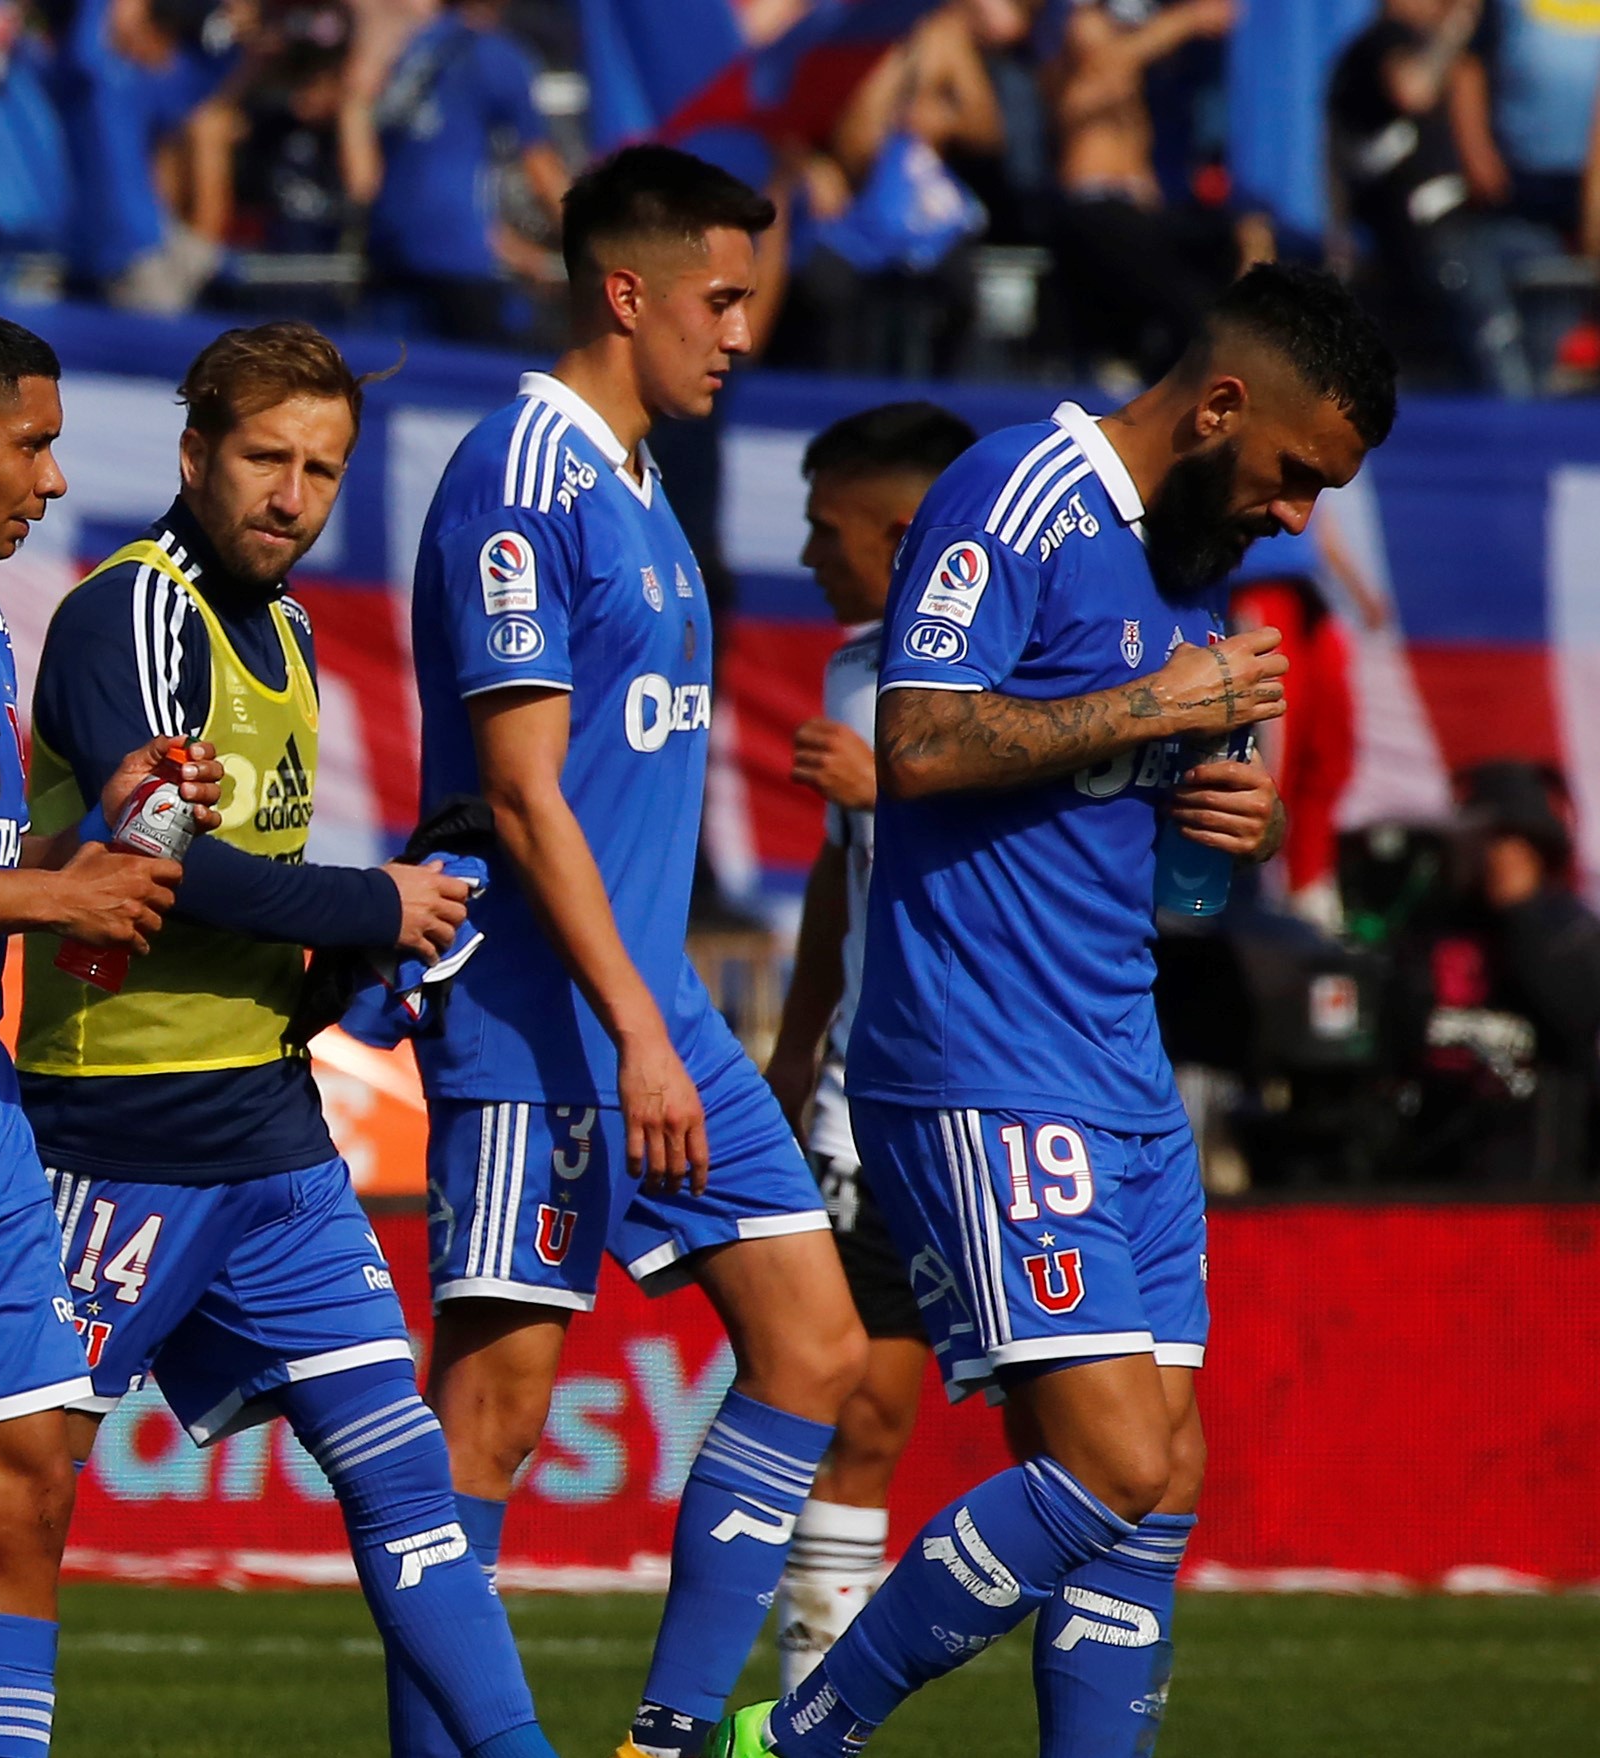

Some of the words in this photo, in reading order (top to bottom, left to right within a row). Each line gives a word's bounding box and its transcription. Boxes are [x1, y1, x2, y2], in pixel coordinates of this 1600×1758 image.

[501, 624, 529, 651] PF
[916, 627, 953, 654] PF
[1000, 1123, 1095, 1221] 19
[70, 1198, 163, 1304] 14
